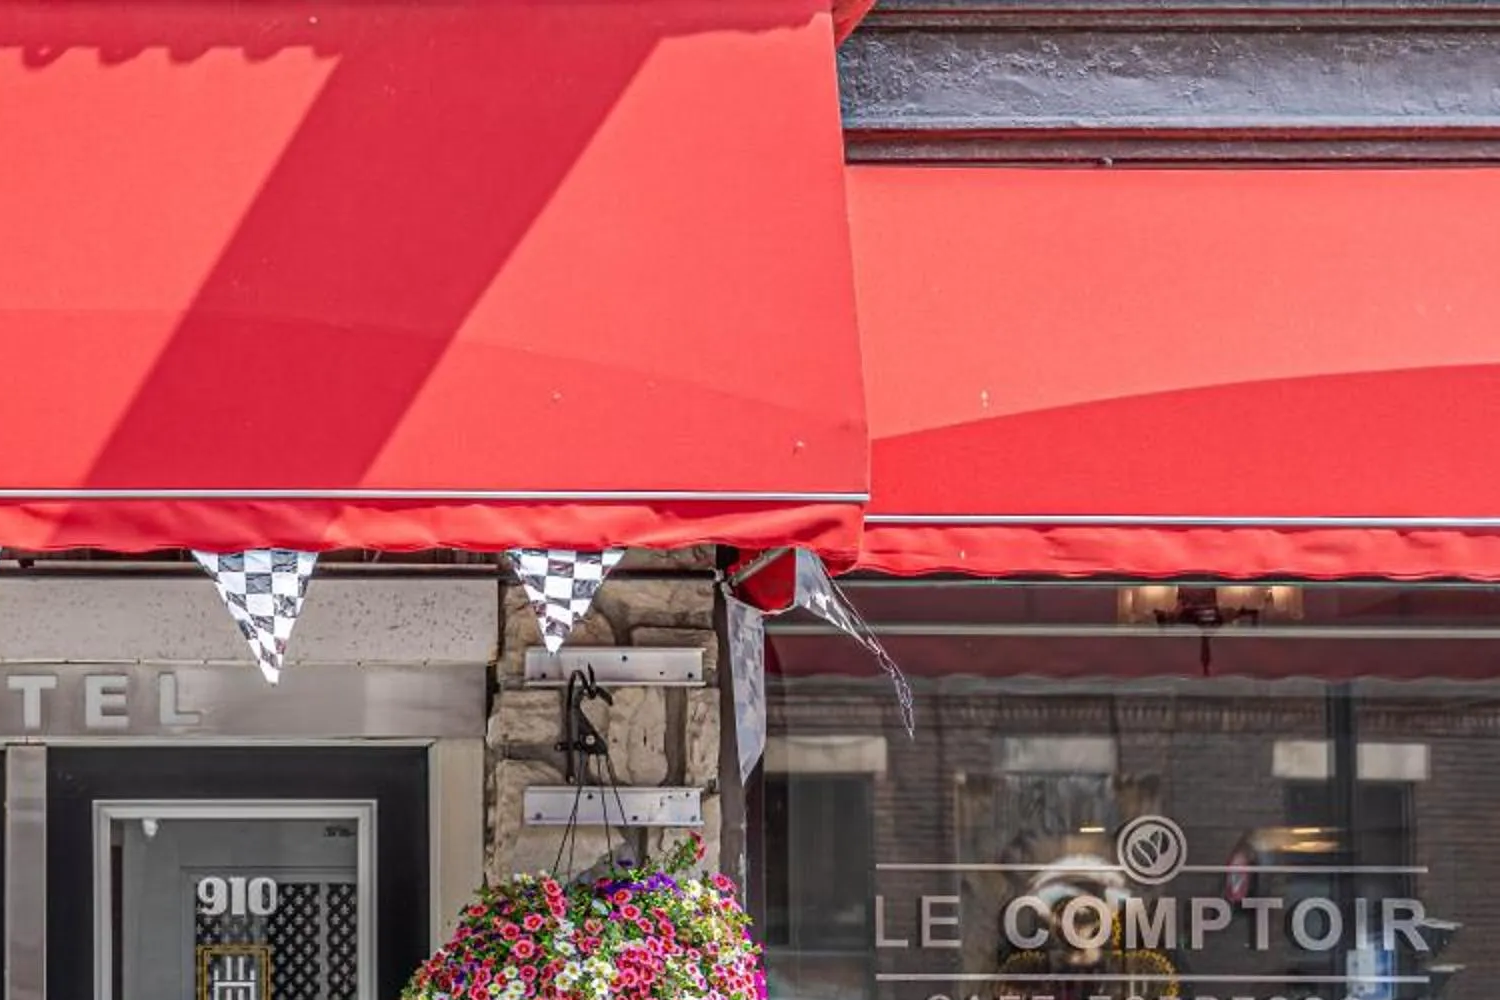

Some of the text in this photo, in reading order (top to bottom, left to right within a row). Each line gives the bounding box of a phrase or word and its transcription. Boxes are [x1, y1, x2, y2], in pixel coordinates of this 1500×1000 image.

[197, 876, 278, 916] 910
[874, 895, 1430, 951] LE COMPTOIR
